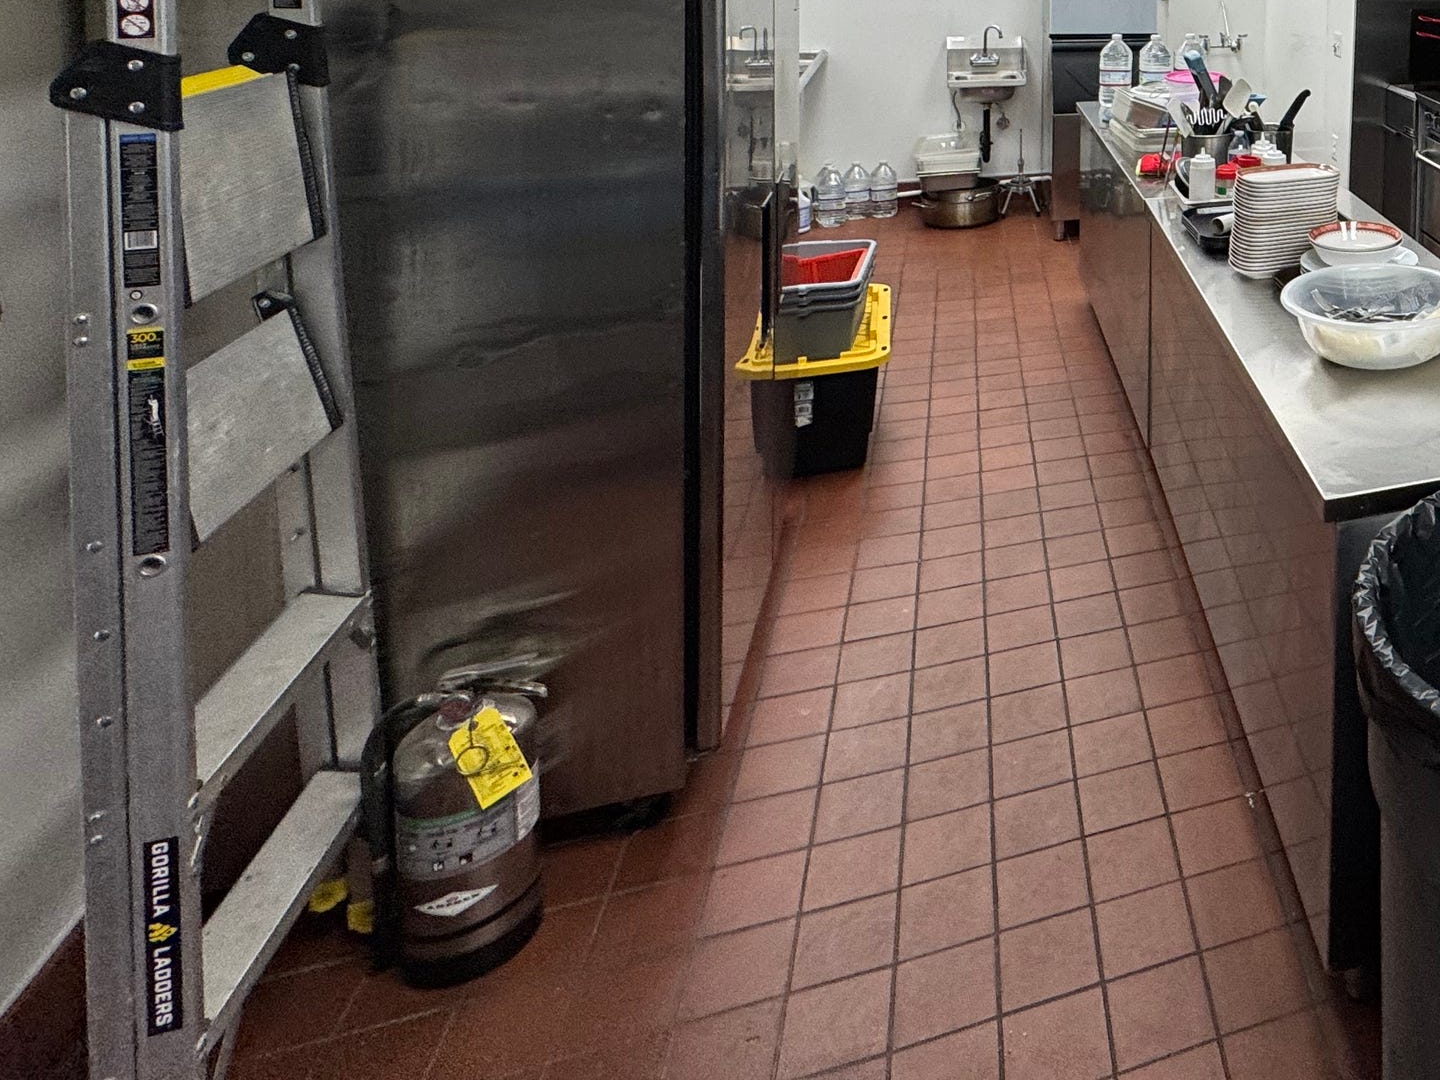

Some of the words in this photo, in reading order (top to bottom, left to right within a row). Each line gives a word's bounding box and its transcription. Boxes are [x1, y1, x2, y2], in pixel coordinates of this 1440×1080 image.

[130, 332, 157, 343] 300
[151, 841, 170, 919] GORILLA
[153, 945, 174, 1027] LADDERS
